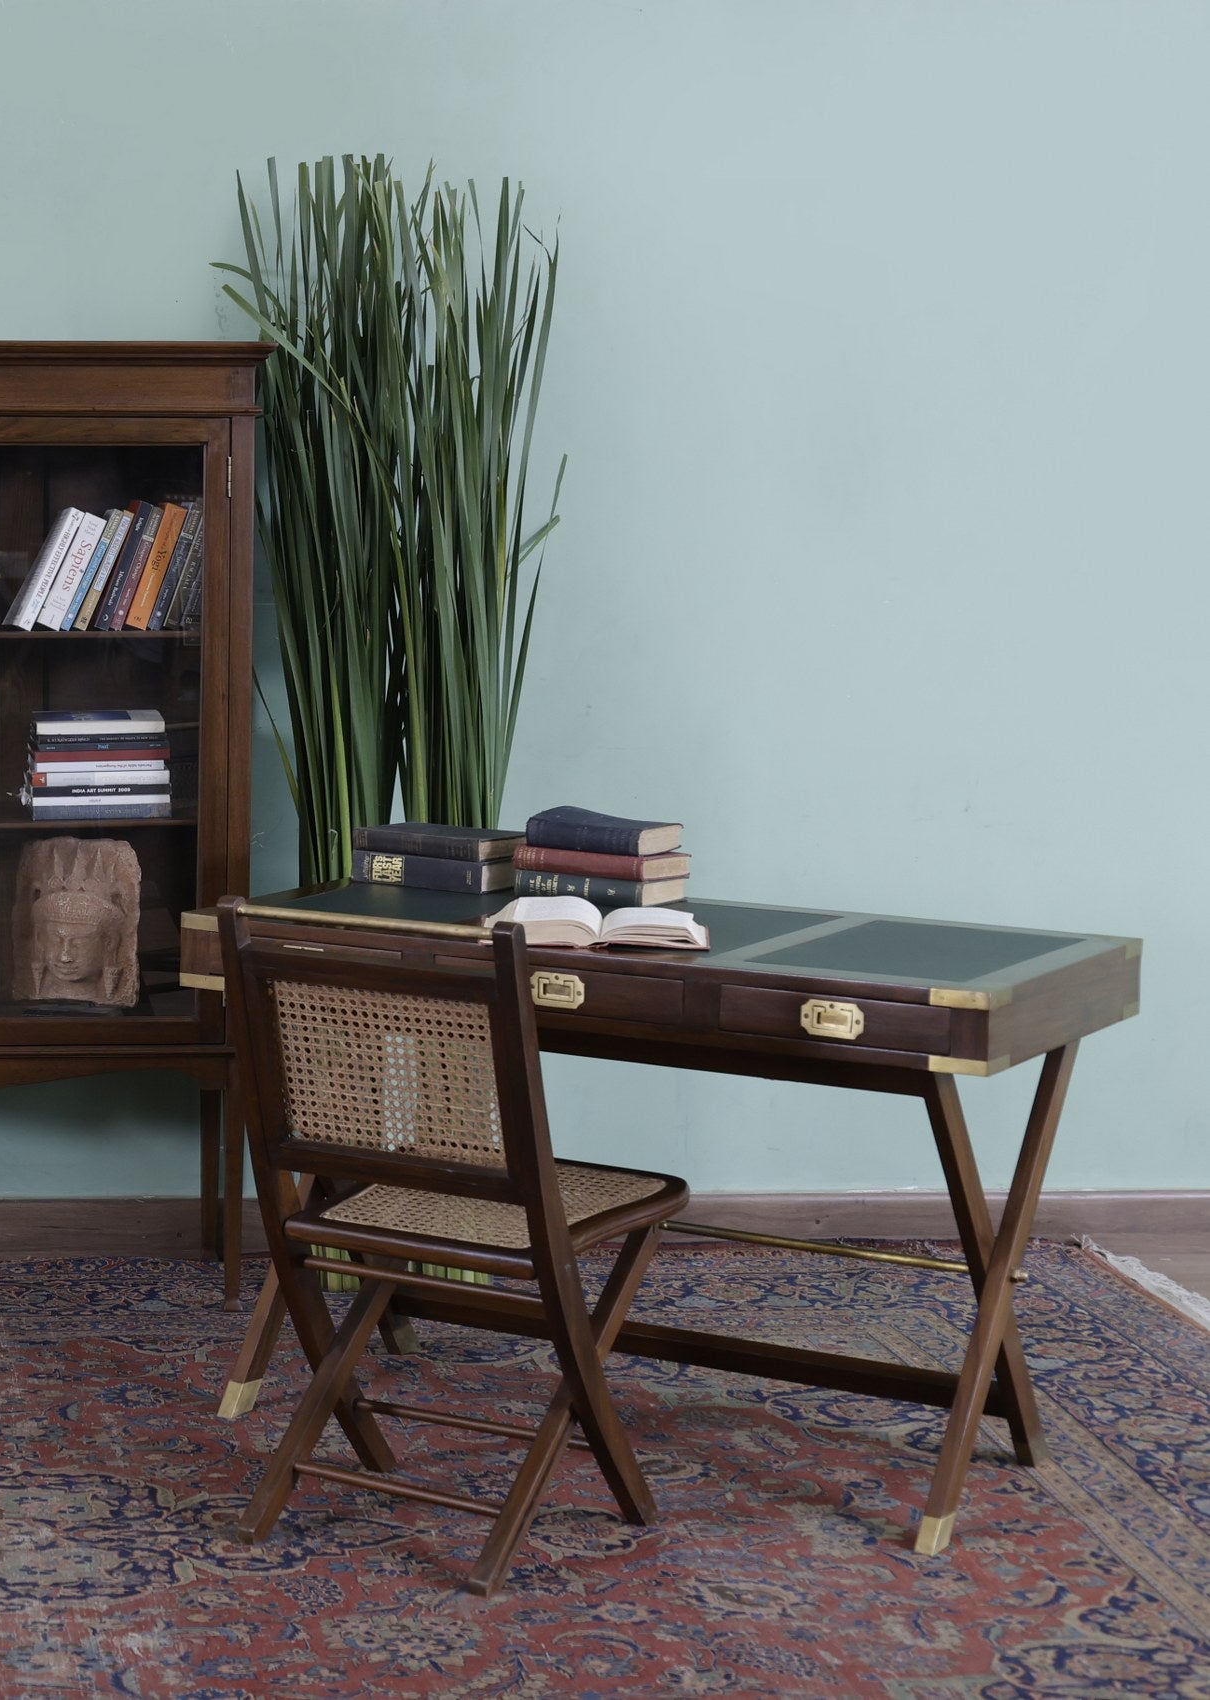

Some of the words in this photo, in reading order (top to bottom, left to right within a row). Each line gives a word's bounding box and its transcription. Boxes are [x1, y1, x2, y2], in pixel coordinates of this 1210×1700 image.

[47, 549, 63, 580] EFFECTIVE
[62, 540, 92, 592] Sapiens
[152, 550, 167, 572] Yogi
[36, 577, 51, 599] PEOPLE
[382, 856, 392, 881] LAST
[392, 857, 403, 882] YEAR
